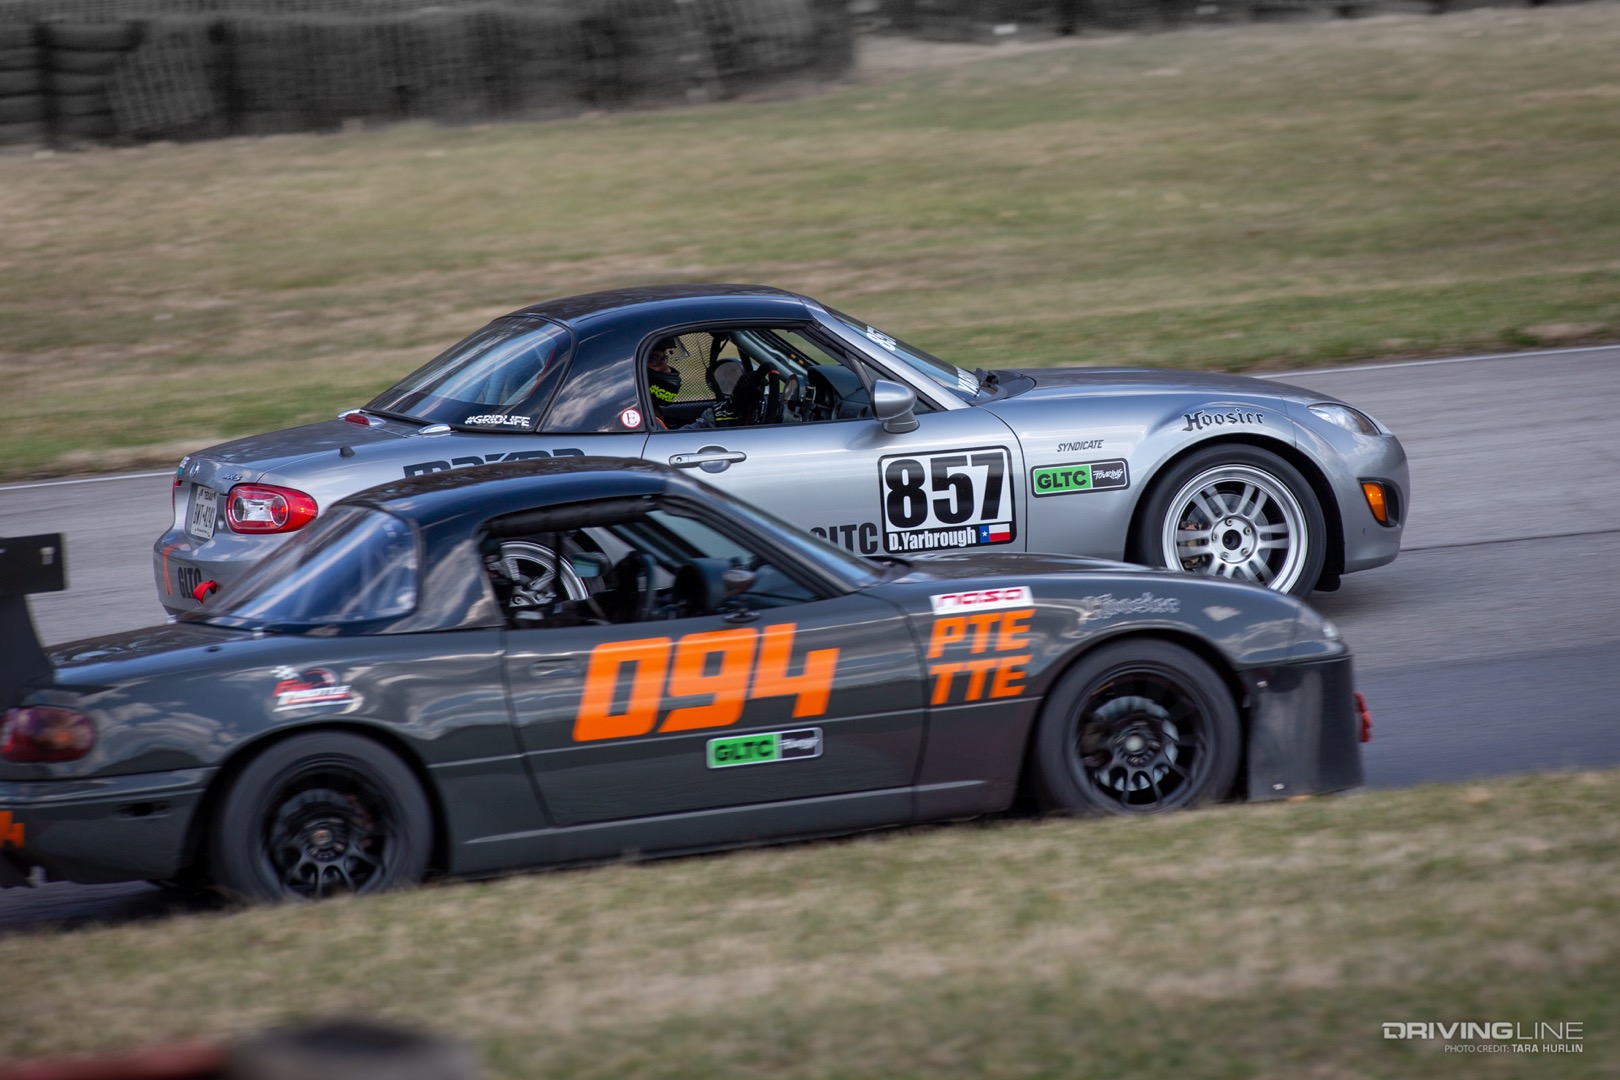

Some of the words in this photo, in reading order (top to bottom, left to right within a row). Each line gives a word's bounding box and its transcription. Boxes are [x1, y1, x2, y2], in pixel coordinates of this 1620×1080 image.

[465, 414, 531, 427] #GRIDLIFE
[1182, 408, 1264, 432] Hoosier
[1056, 440, 1104, 452] SYNDICATE
[885, 452, 1005, 528] 857
[1037, 470, 1087, 490] GLTC
[888, 527, 977, 551] D.Yarbrough
[927, 609, 1036, 659] PTE
[571, 623, 840, 742] 094
[929, 654, 1034, 705] TTE
[714, 740, 774, 762] GLTC
